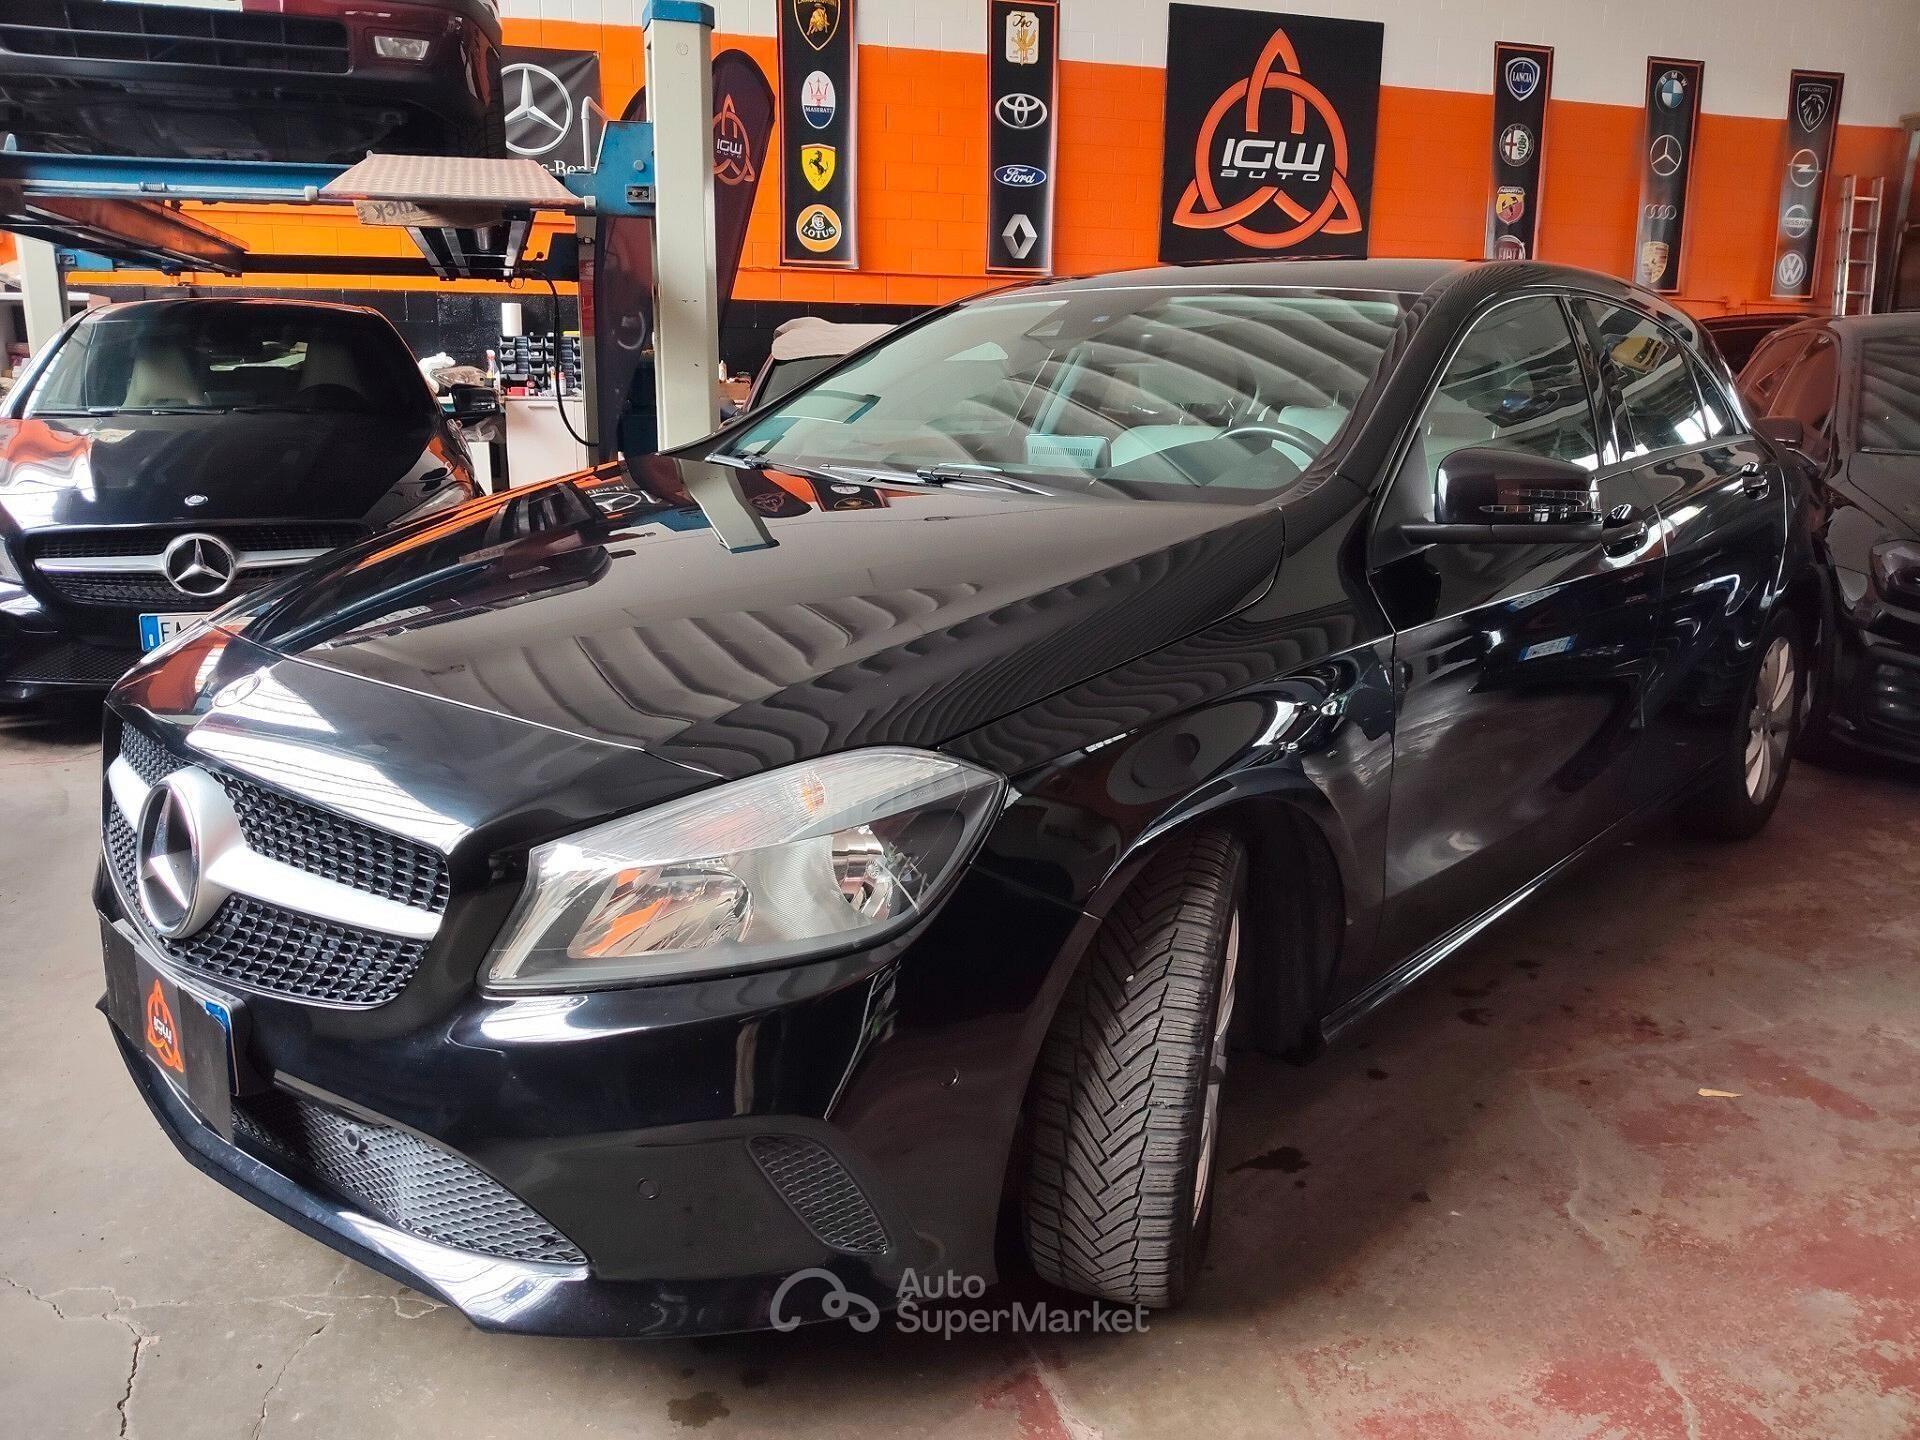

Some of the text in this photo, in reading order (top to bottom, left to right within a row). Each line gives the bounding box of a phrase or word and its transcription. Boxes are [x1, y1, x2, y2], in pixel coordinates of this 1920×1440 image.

[1660, 72, 1688, 87] BMW
[717, 138, 743, 155] IGW
[1221, 138, 1326, 172] IGW
[1003, 167, 1036, 184] Ford
[802, 224, 836, 239] LOTUS
[153, 1015, 172, 1045] IGW
